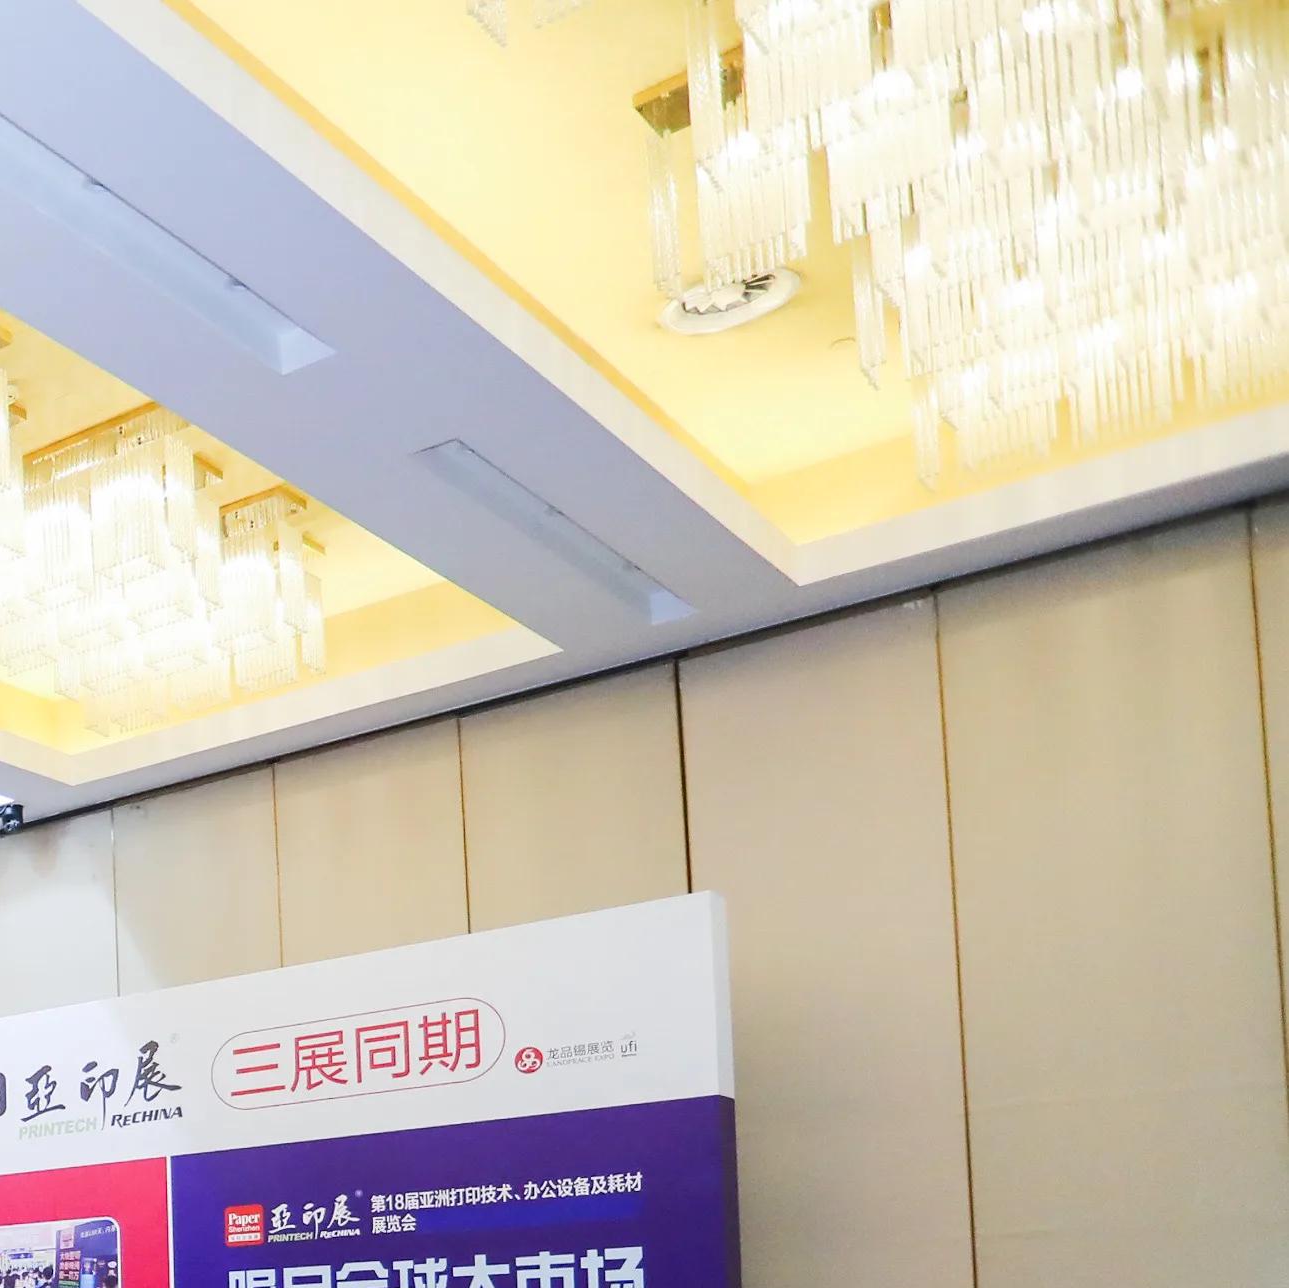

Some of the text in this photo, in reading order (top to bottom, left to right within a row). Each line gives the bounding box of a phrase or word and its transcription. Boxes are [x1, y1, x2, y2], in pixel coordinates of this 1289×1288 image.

[230, 1008, 482, 1097] 三展同期
[18, 1116, 98, 1141] PRINTECH
[370, 1171, 643, 1213] 第18届亚洲打印技术、办公设备及耗材
[227, 1212, 261, 1228] Paper
[228, 1224, 261, 1234] Shenzhen
[371, 1213, 417, 1235] 展览会
[267, 1230, 314, 1243] PRINTECH
